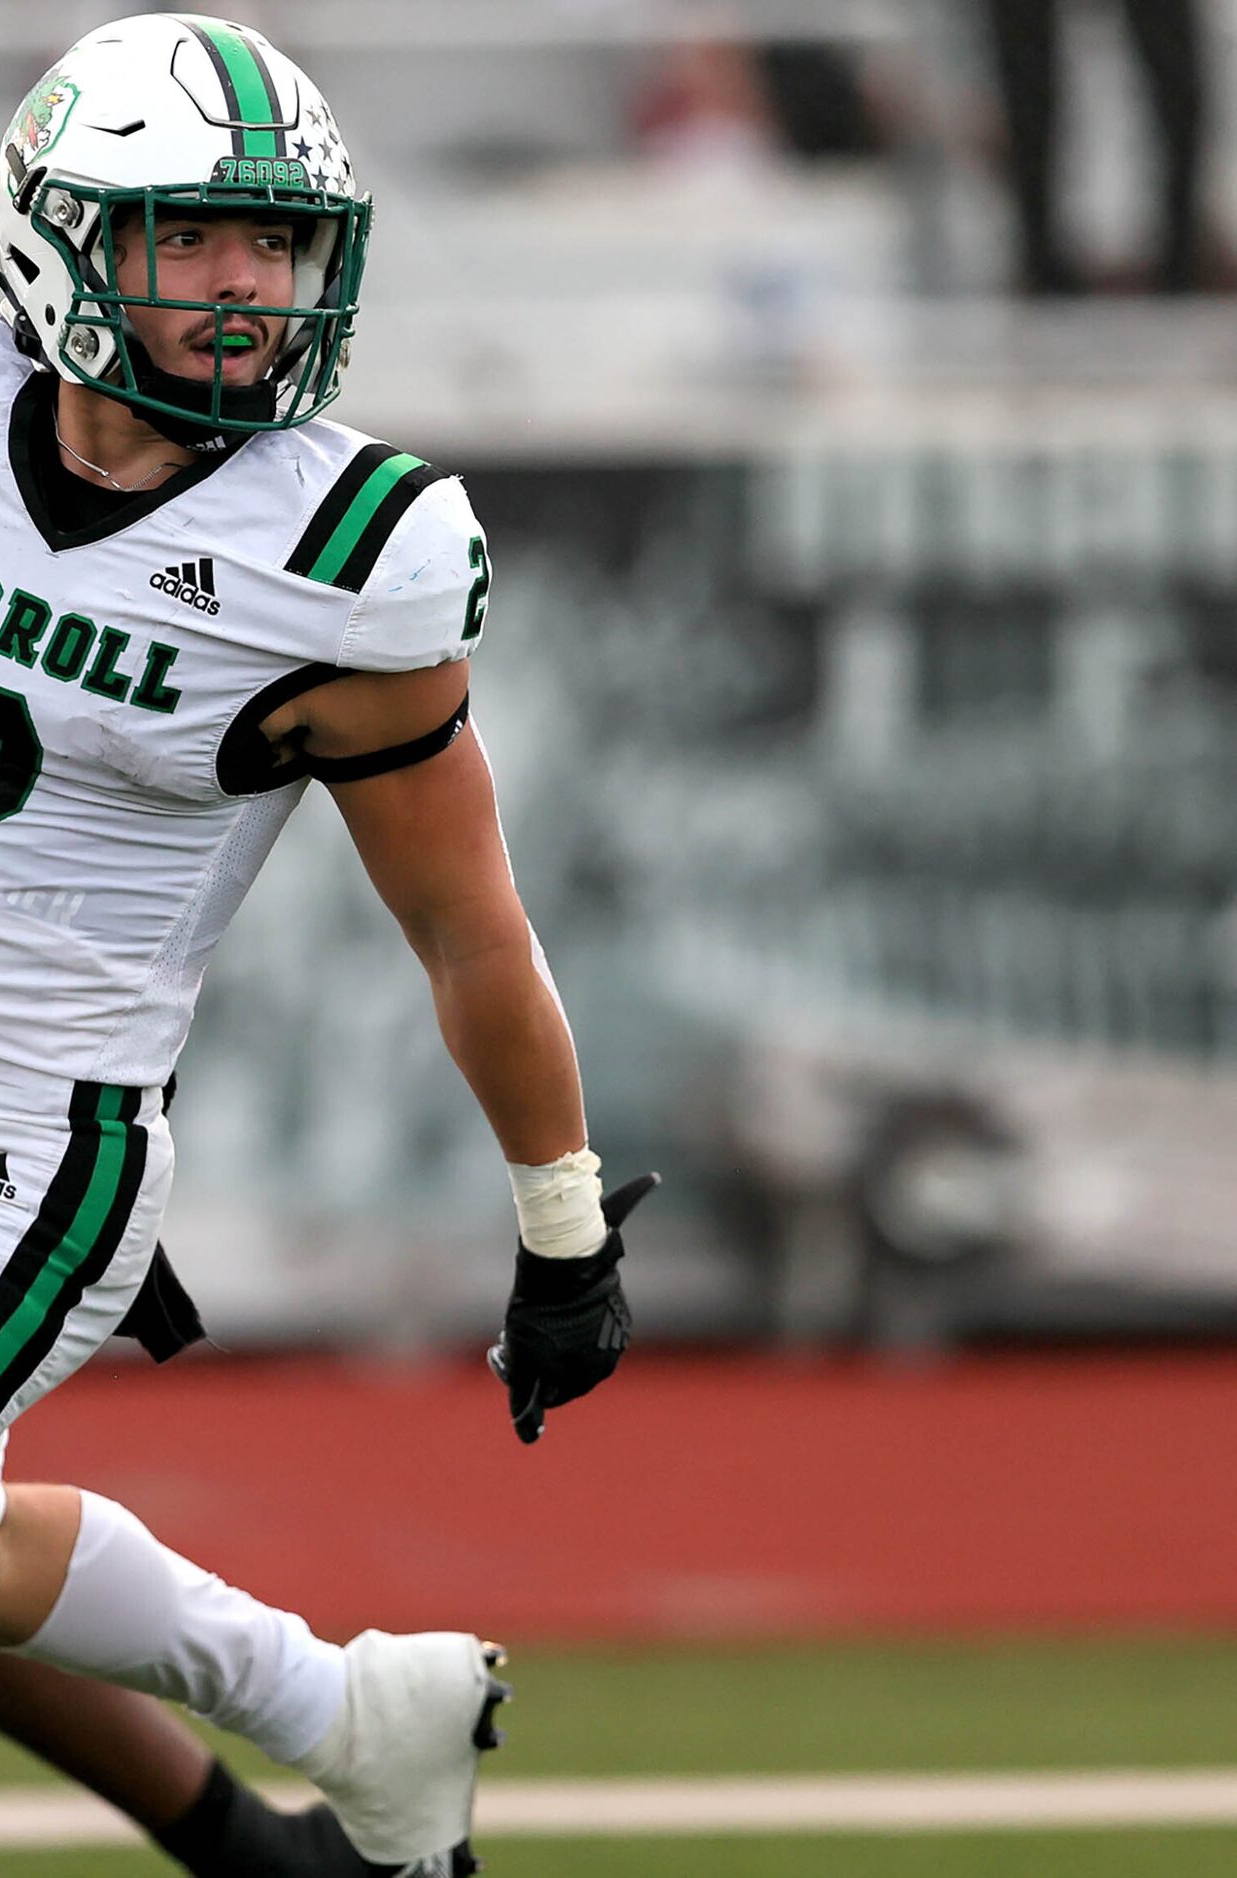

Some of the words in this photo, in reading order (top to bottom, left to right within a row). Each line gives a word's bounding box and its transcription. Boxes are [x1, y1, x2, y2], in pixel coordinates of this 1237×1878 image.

[220, 160, 304, 187] 76092
[149, 572, 221, 616] adidas
[460, 536, 490, 640] 2
